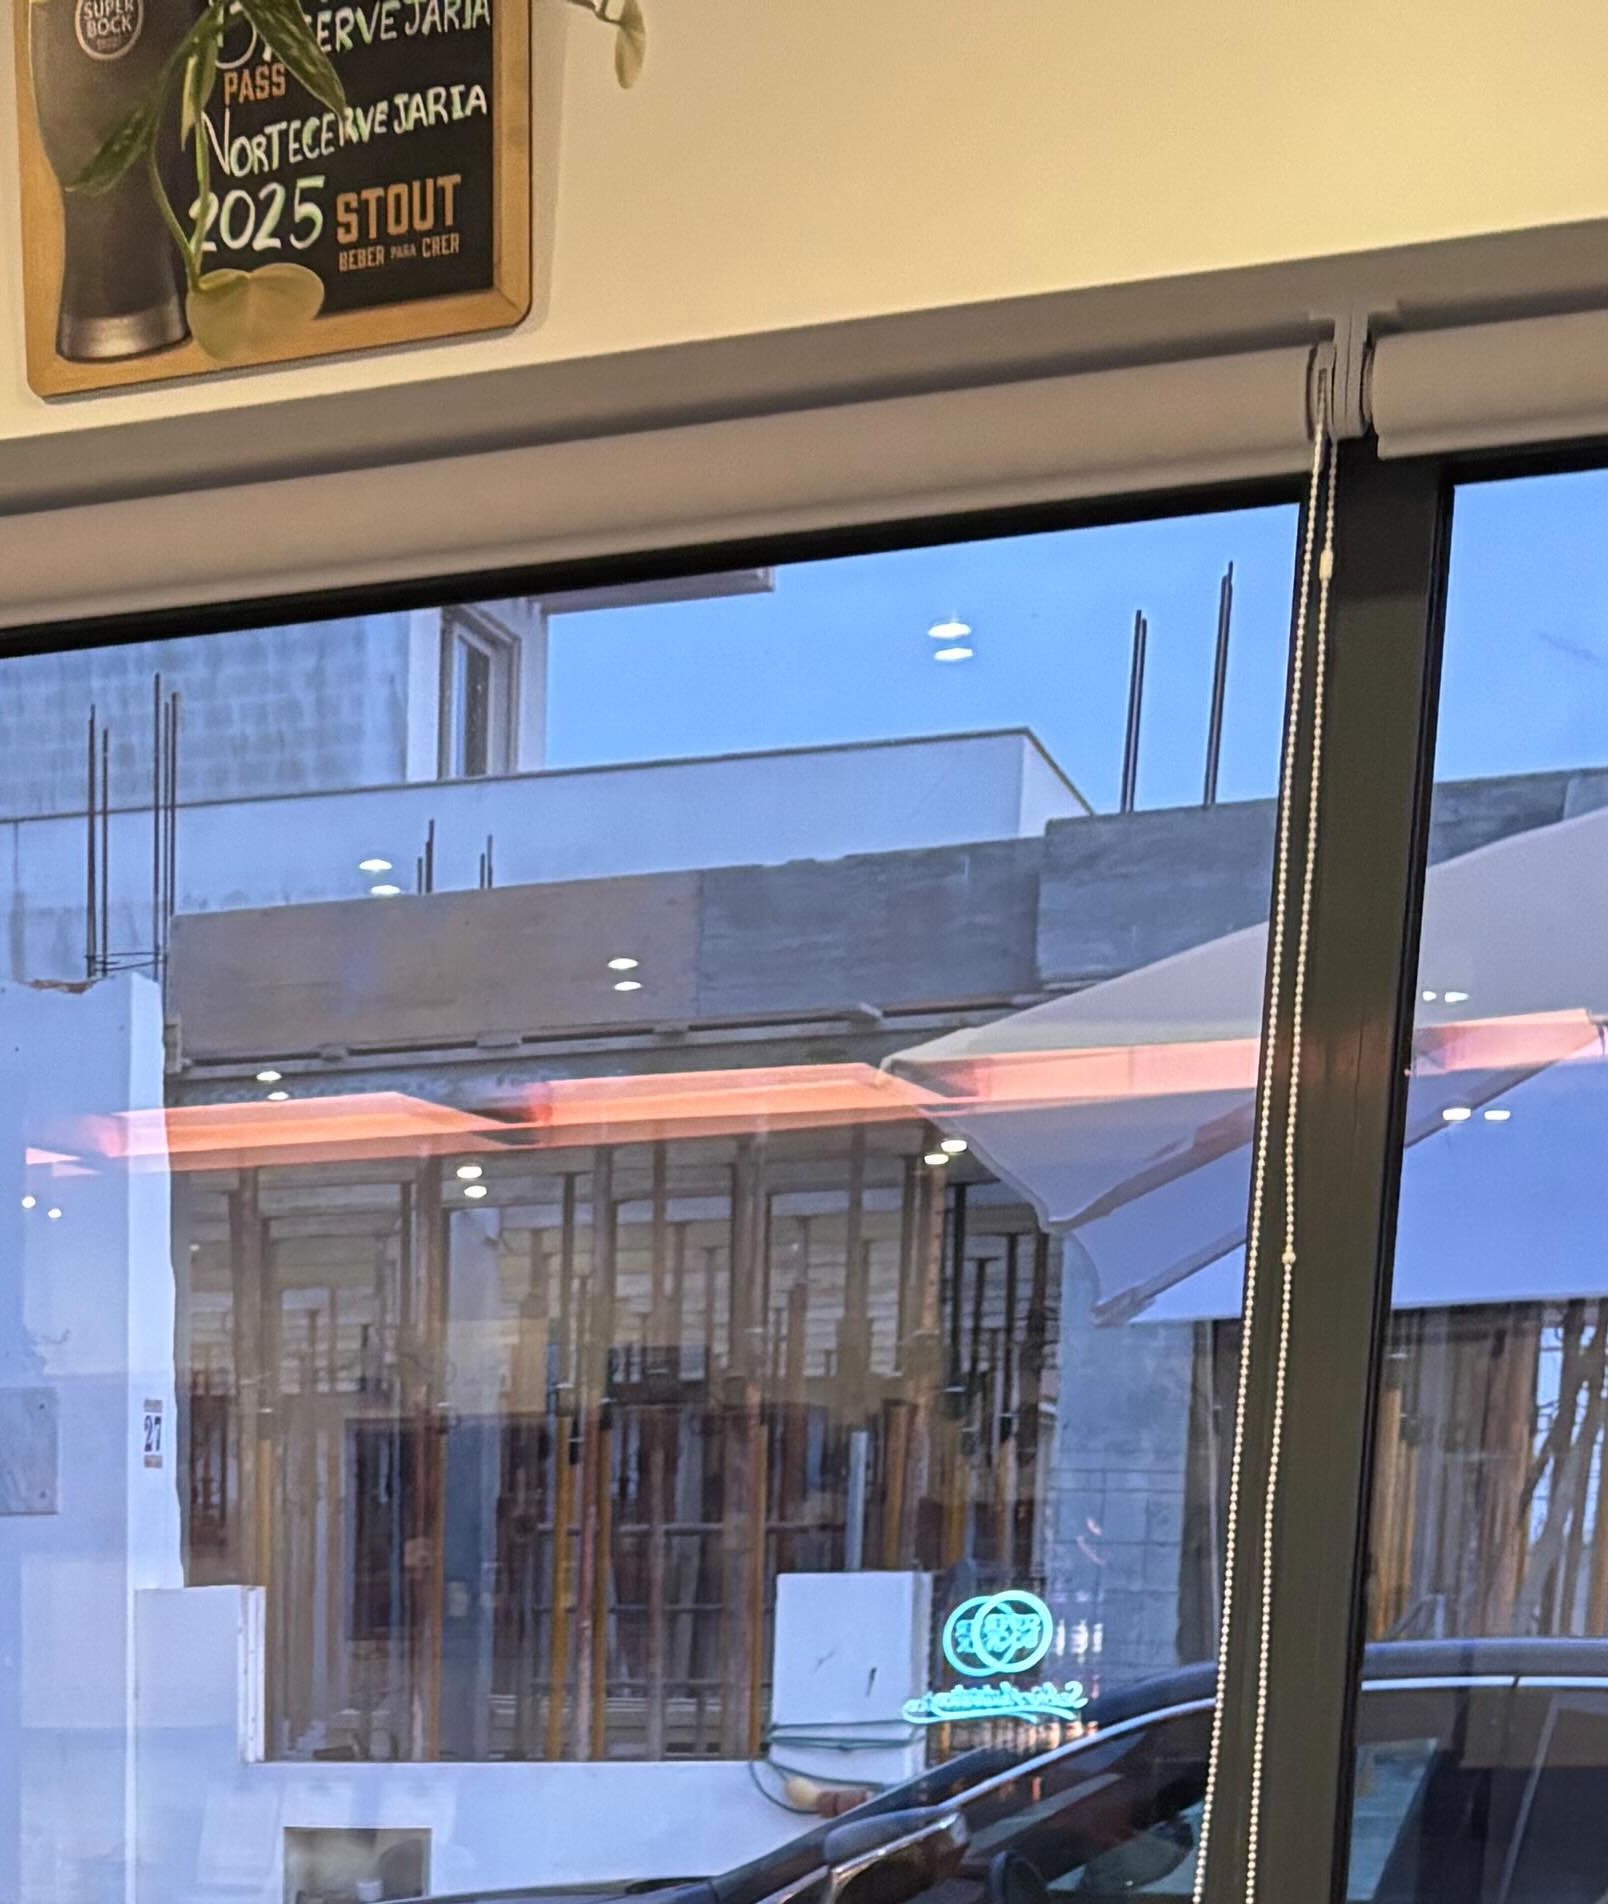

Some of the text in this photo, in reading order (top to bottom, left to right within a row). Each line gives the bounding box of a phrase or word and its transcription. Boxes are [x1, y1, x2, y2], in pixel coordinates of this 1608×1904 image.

[85, 14, 133, 39] BOCK
[188, 174, 327, 252] 2025
[336, 173, 462, 246] STOUT
[339, 244, 385, 273] BEBER
[421, 232, 460, 259] CRER
[143, 1415, 163, 1453] 27
